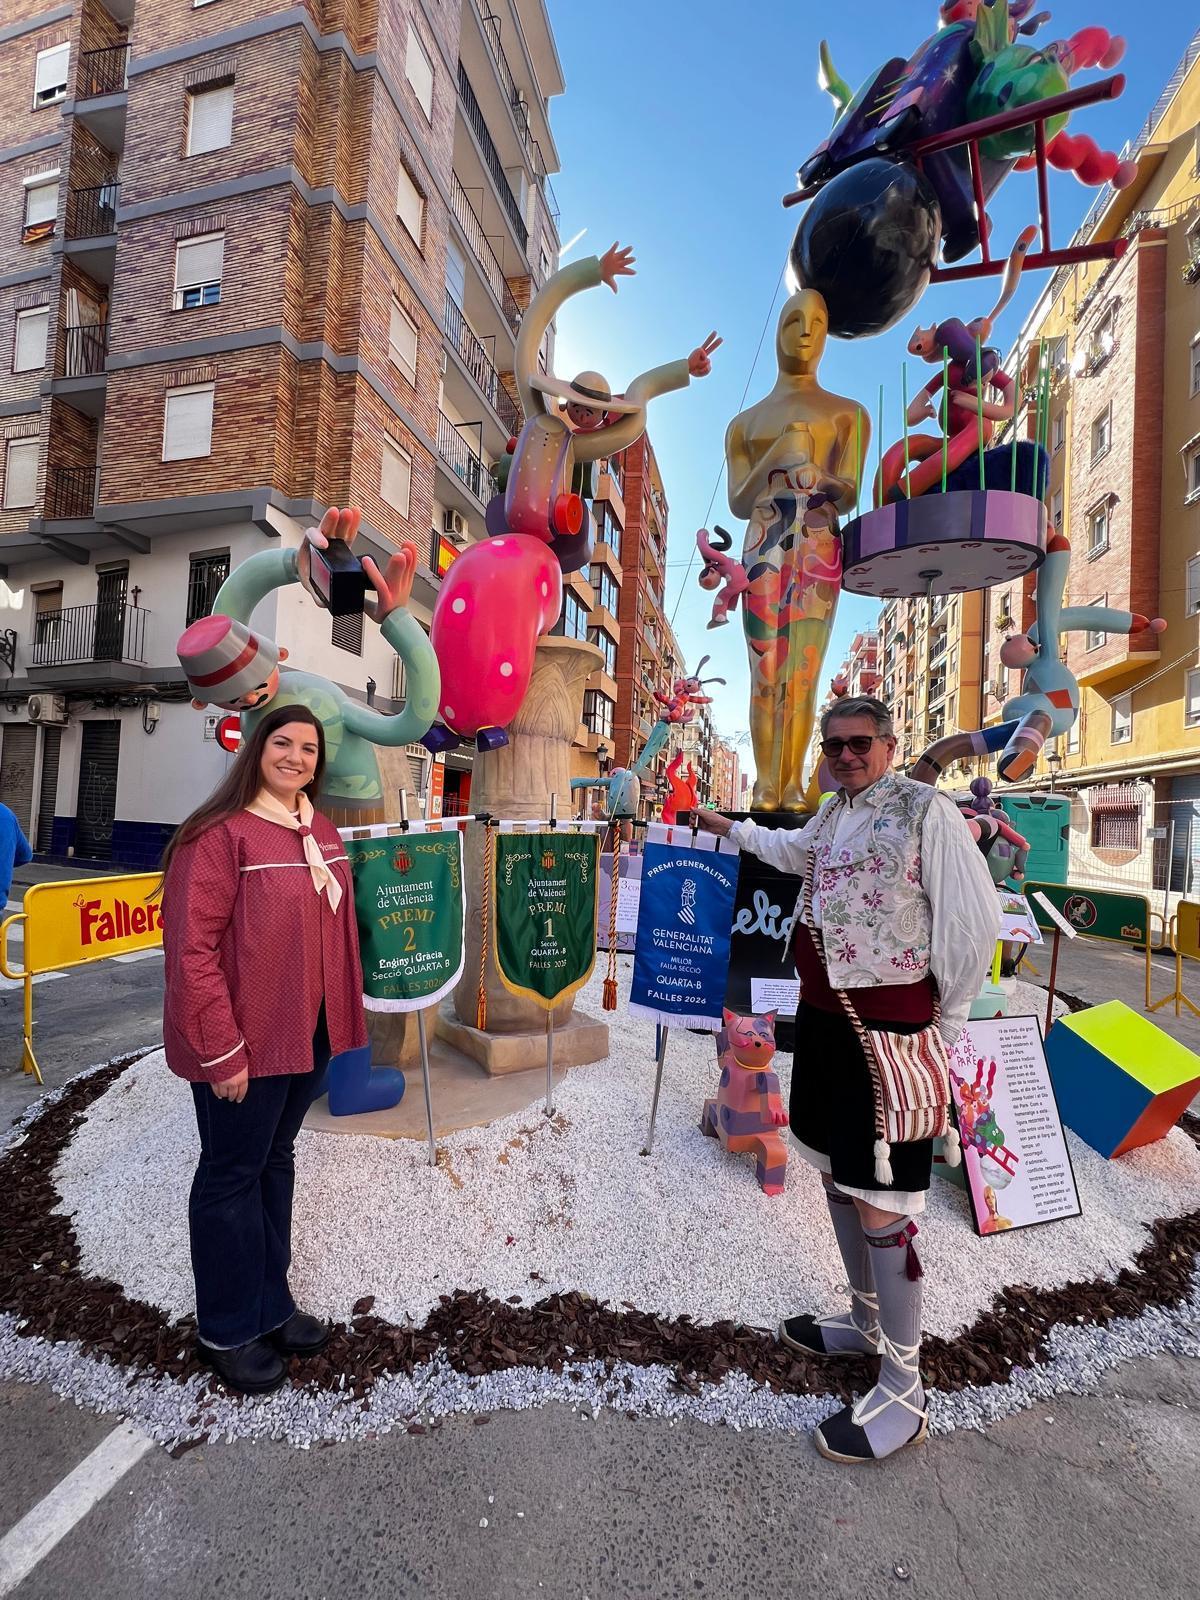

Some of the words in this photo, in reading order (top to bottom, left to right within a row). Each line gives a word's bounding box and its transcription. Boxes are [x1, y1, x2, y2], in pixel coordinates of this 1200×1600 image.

[849, 567, 872, 576] 12
[648, 861, 674, 877] PREMI
[676, 860, 732, 888] GENERALITAT
[376, 880, 433, 897] Ajuntament
[528, 879, 566, 888] Ajuntament
[73, 894, 86, 908] La
[378, 898, 390, 908] de
[393, 892, 434, 906] València
[528, 902, 566, 916] PREMI
[378, 908, 436, 930] PREMI
[544, 918, 554, 937] 1
[404, 927, 416, 951] 2
[653, 928, 714, 945] GENERALITAT
[653, 938, 712, 955] VALENCIANA
[379, 957, 409, 968] Enginy
[411, 955, 414, 963] i
[416, 951, 443, 962] Gràcia
[660, 962, 677, 970] FALLA
[671, 956, 692, 965] MILLOR
[372, 970, 401, 980] Secció
[405, 962, 443, 975] QUARTA
[445, 959, 450, 967] B
[384, 983, 420, 994] FALLES
[656, 975, 702, 989] QUARTA-B
[648, 990, 682, 1002] FALLES
[685, 996, 706, 1004] 2026
[957, 1055, 976, 1067] PARE
